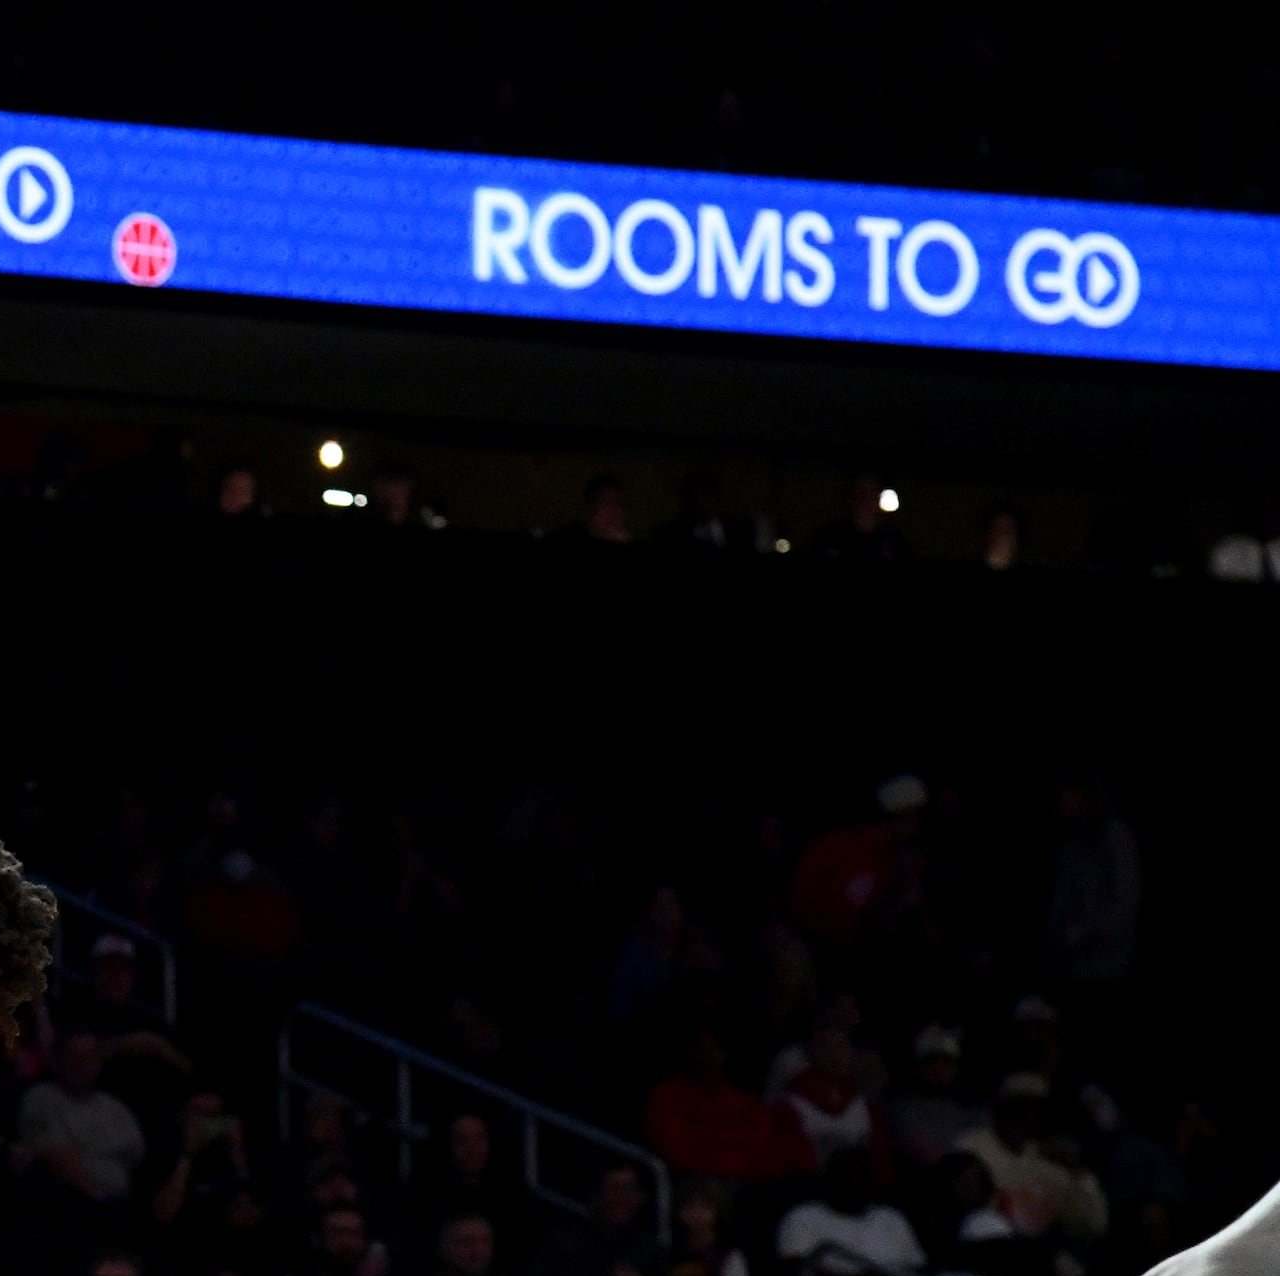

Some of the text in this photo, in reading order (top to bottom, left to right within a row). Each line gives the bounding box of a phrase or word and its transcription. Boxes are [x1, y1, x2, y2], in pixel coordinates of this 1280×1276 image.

[471, 187, 836, 307] ROOMS
[854, 216, 979, 317] TO
[1005, 228, 1140, 328] GO
